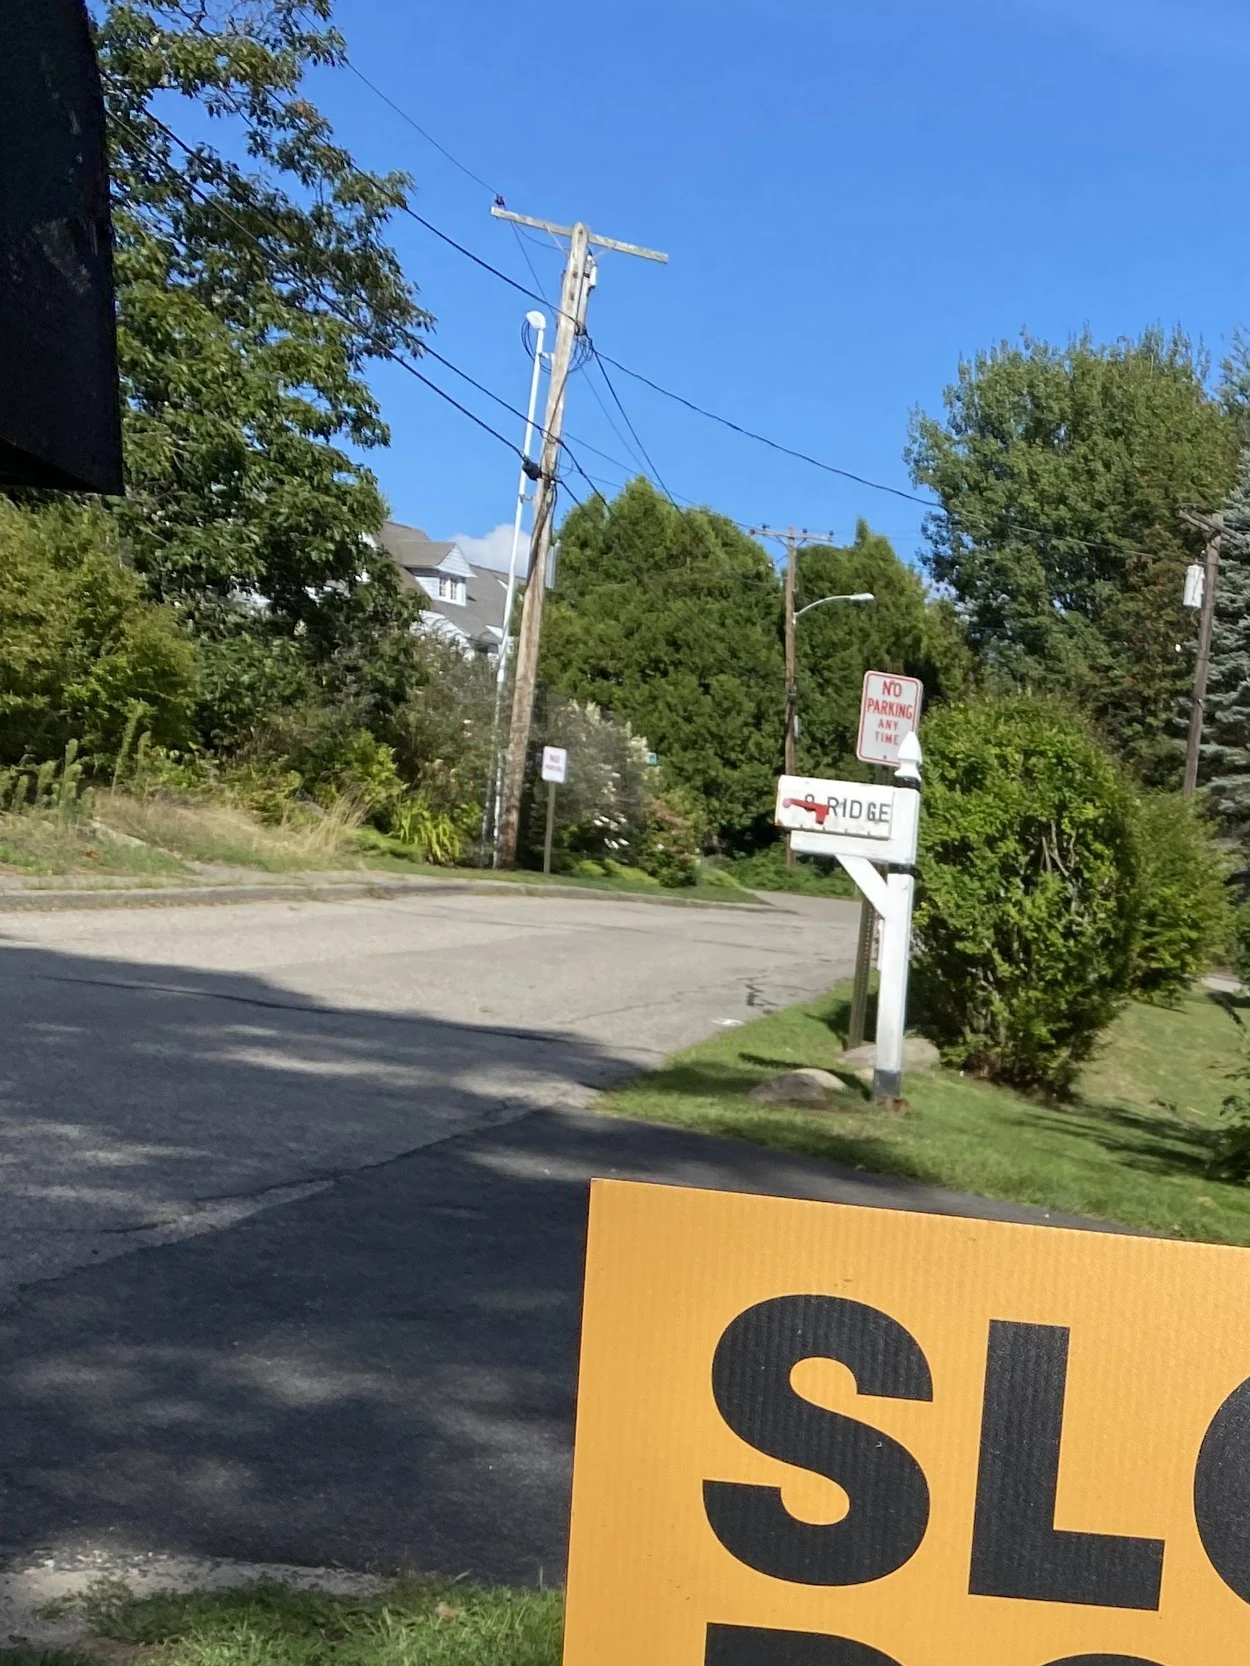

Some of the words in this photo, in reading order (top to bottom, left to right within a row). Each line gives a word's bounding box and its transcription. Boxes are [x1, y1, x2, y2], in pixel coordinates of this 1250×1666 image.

[881, 680, 903, 697] NO
[866, 698, 914, 720] PARKING
[878, 719, 900, 731] ANY
[874, 731, 900, 745] TIME
